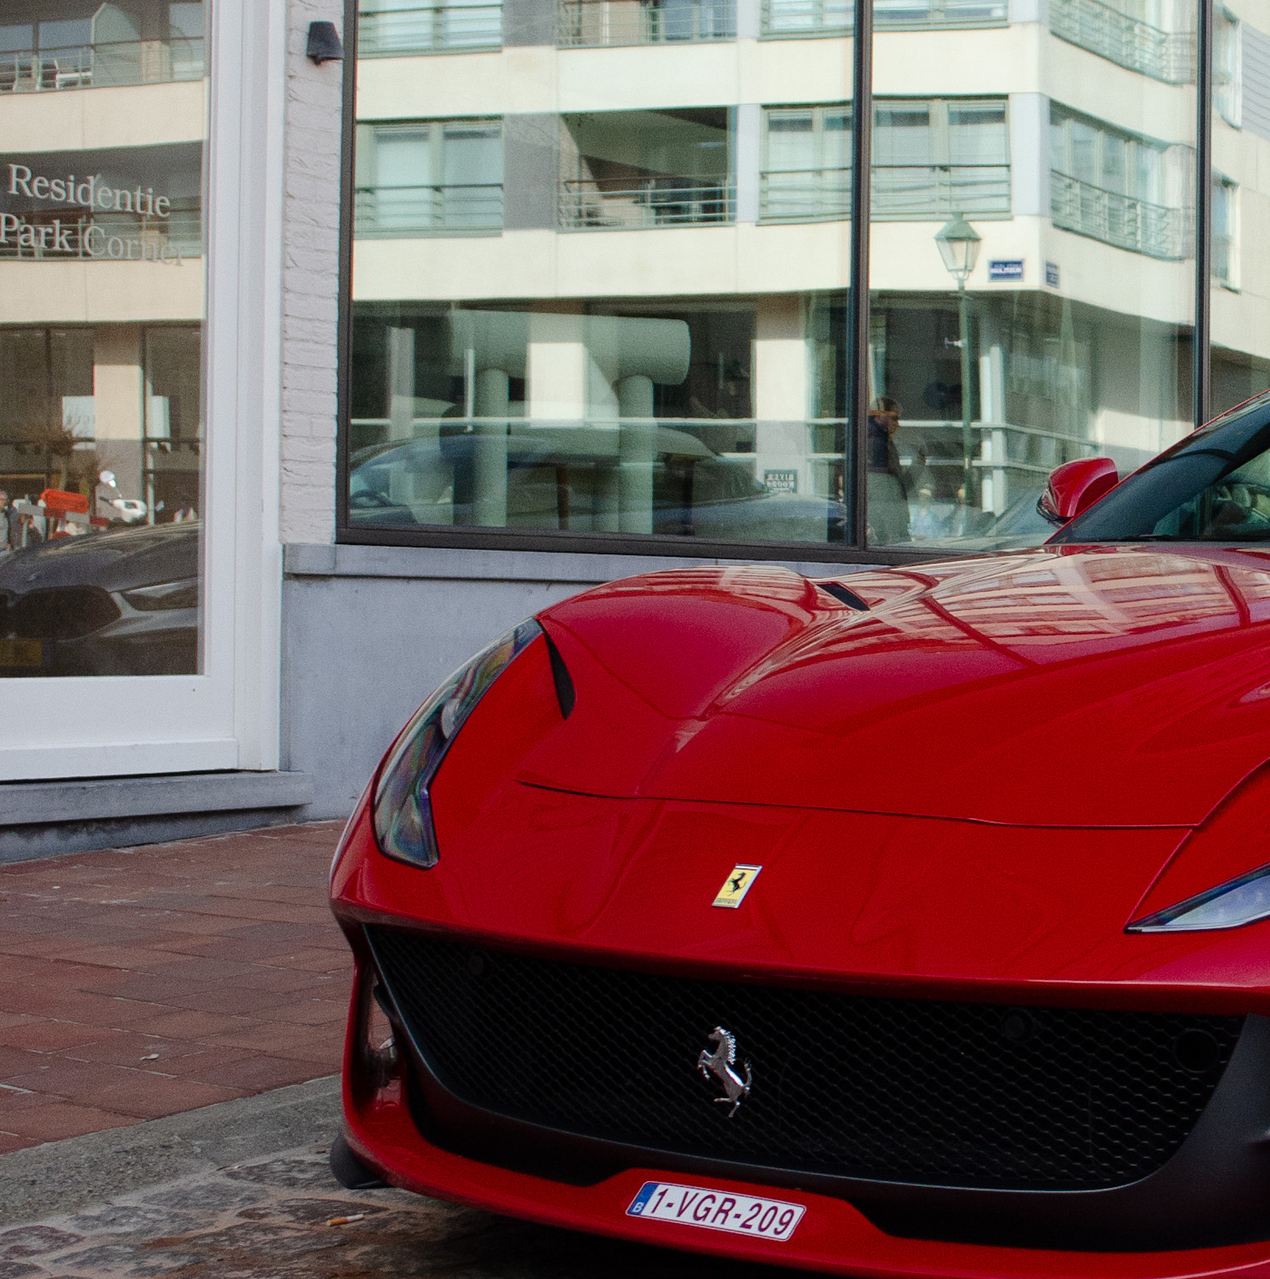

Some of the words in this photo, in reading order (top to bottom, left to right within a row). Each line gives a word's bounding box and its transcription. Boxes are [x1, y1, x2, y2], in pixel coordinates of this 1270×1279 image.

[8, 164, 171, 218] Residentie
[0, 213, 73, 252] Park
[83, 225, 184, 267] Corner
[632, 1201, 644, 1213] B
[651, 1188, 795, 1236] 1-VGR-209
